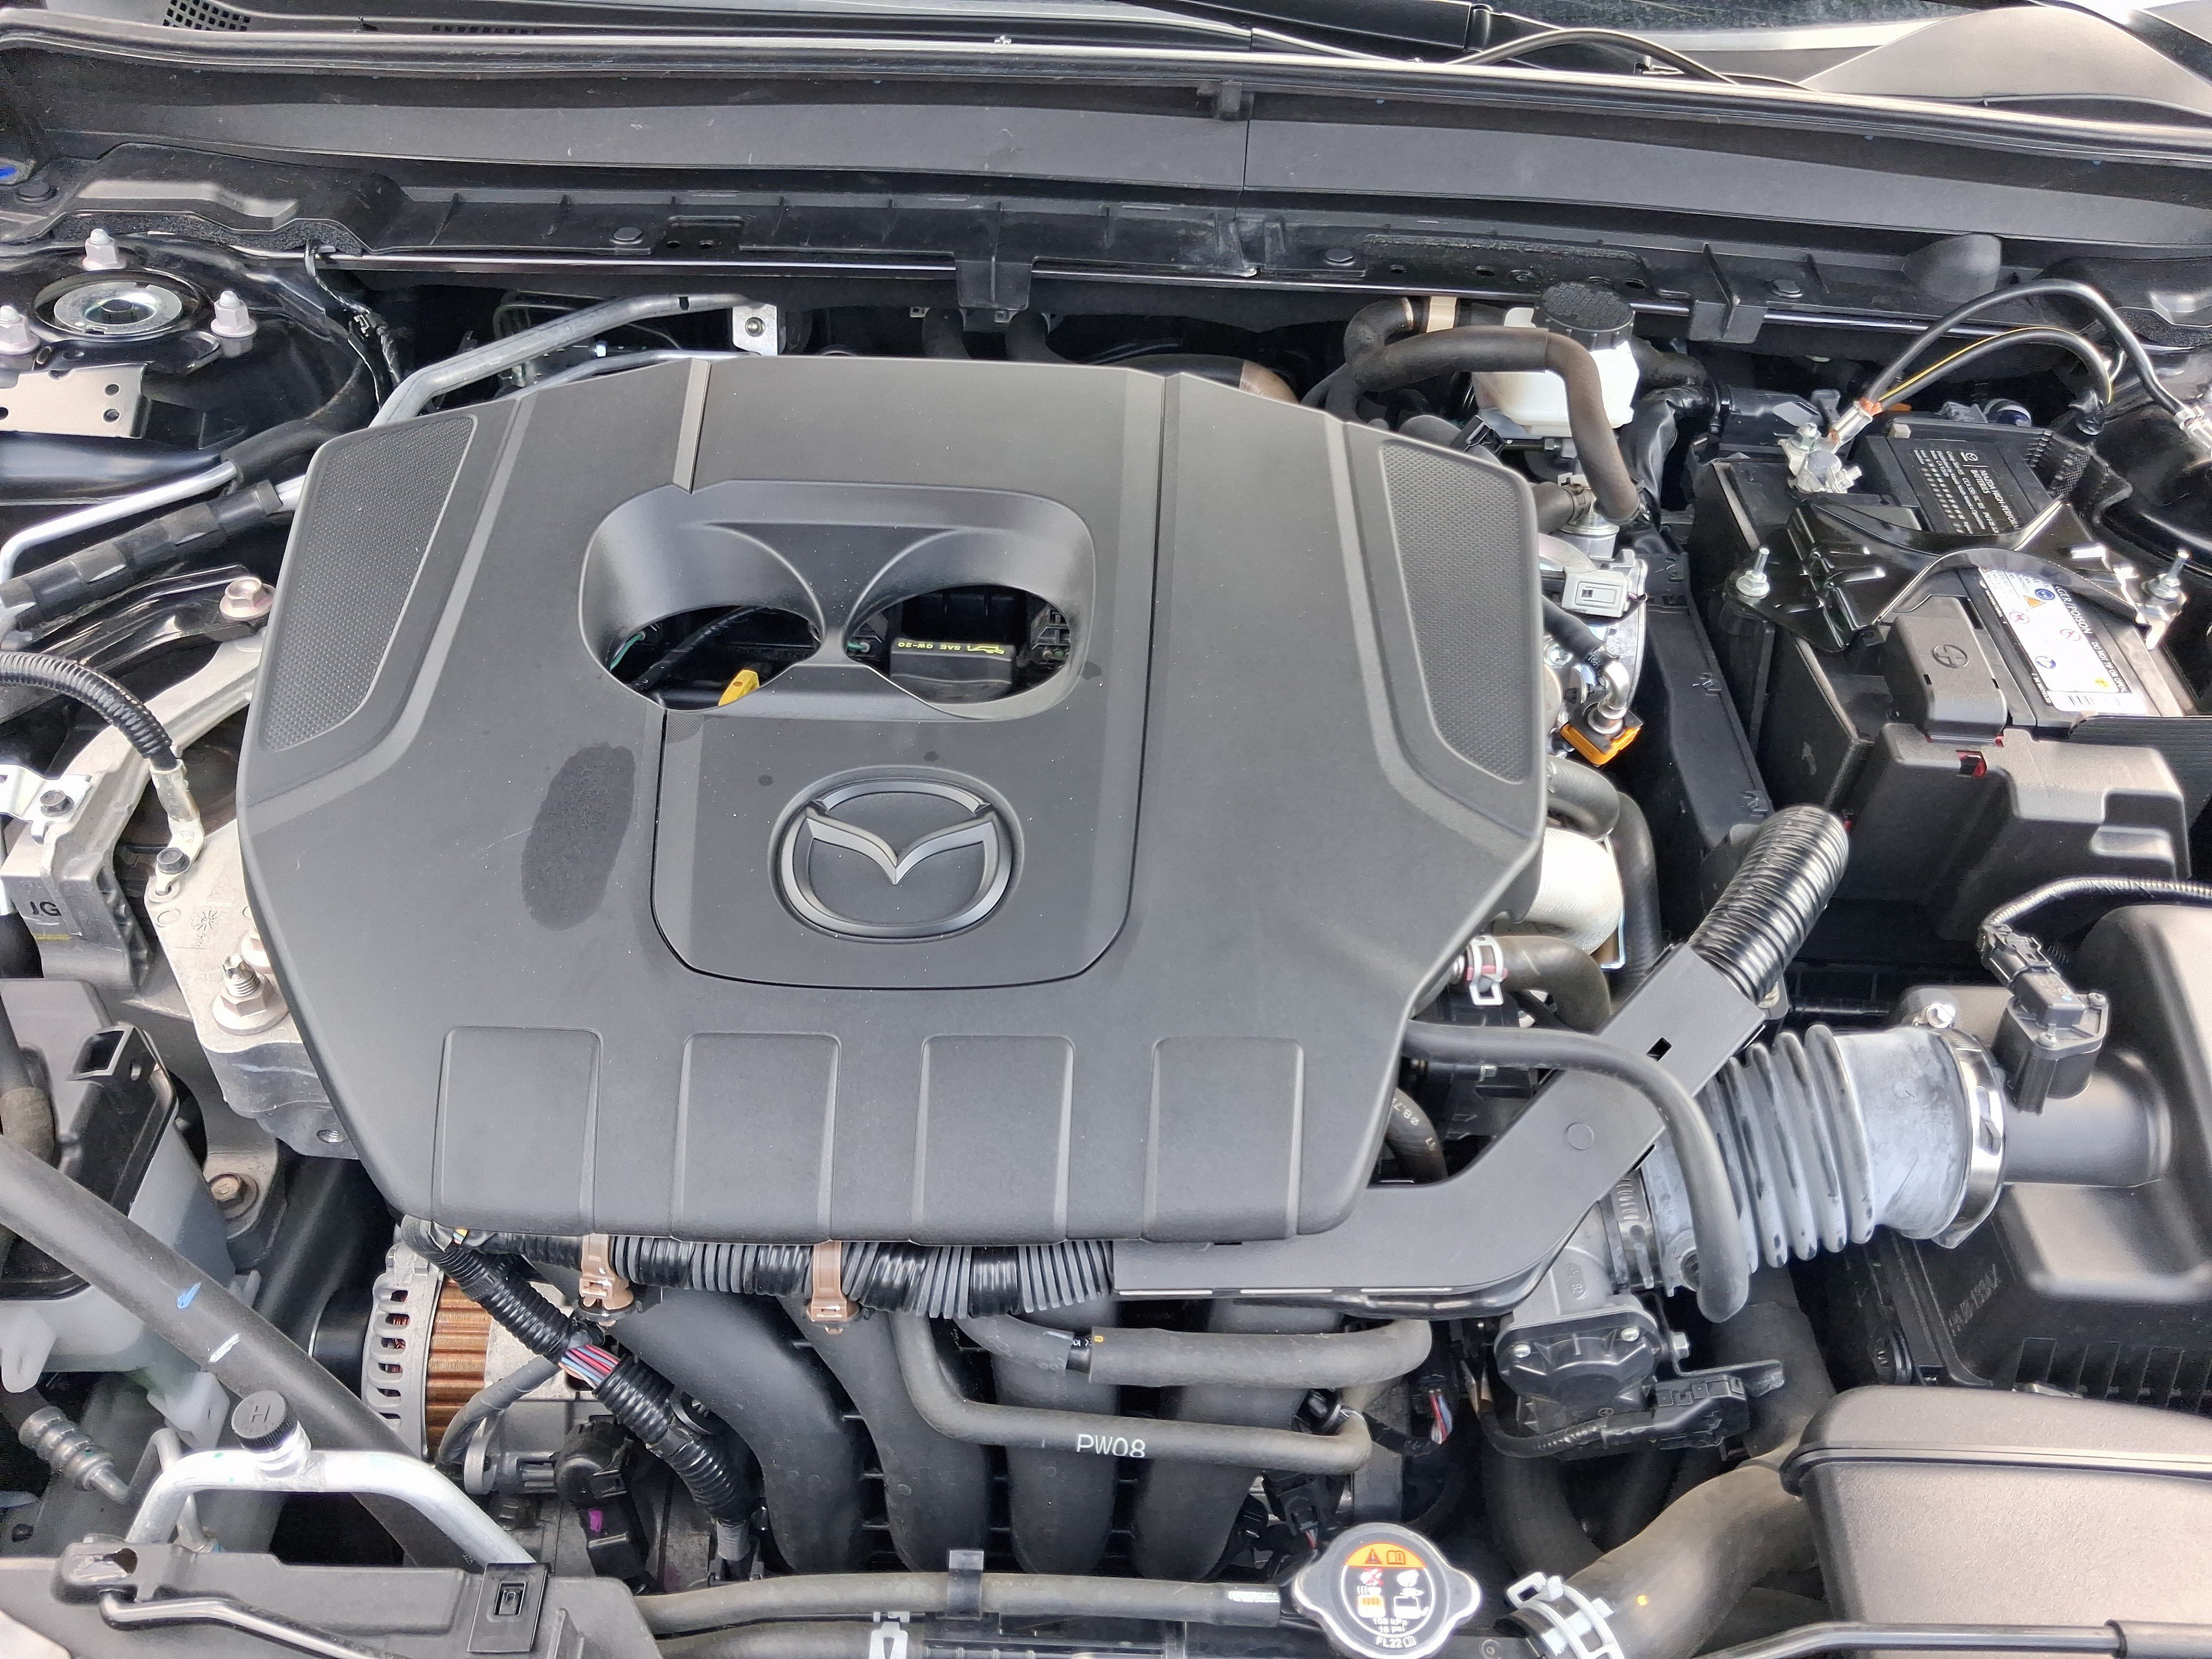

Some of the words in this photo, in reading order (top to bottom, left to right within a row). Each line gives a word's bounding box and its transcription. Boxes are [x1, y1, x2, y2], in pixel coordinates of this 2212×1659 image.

[1970, 470, 1990, 494] BATTERIES
[1979, 470, 1995, 490] MAZDA
[2096, 650, 2108, 661] NOT
[1076, 1433, 1146, 1458] PW08
[1375, 1636, 1403, 1648] FL22
